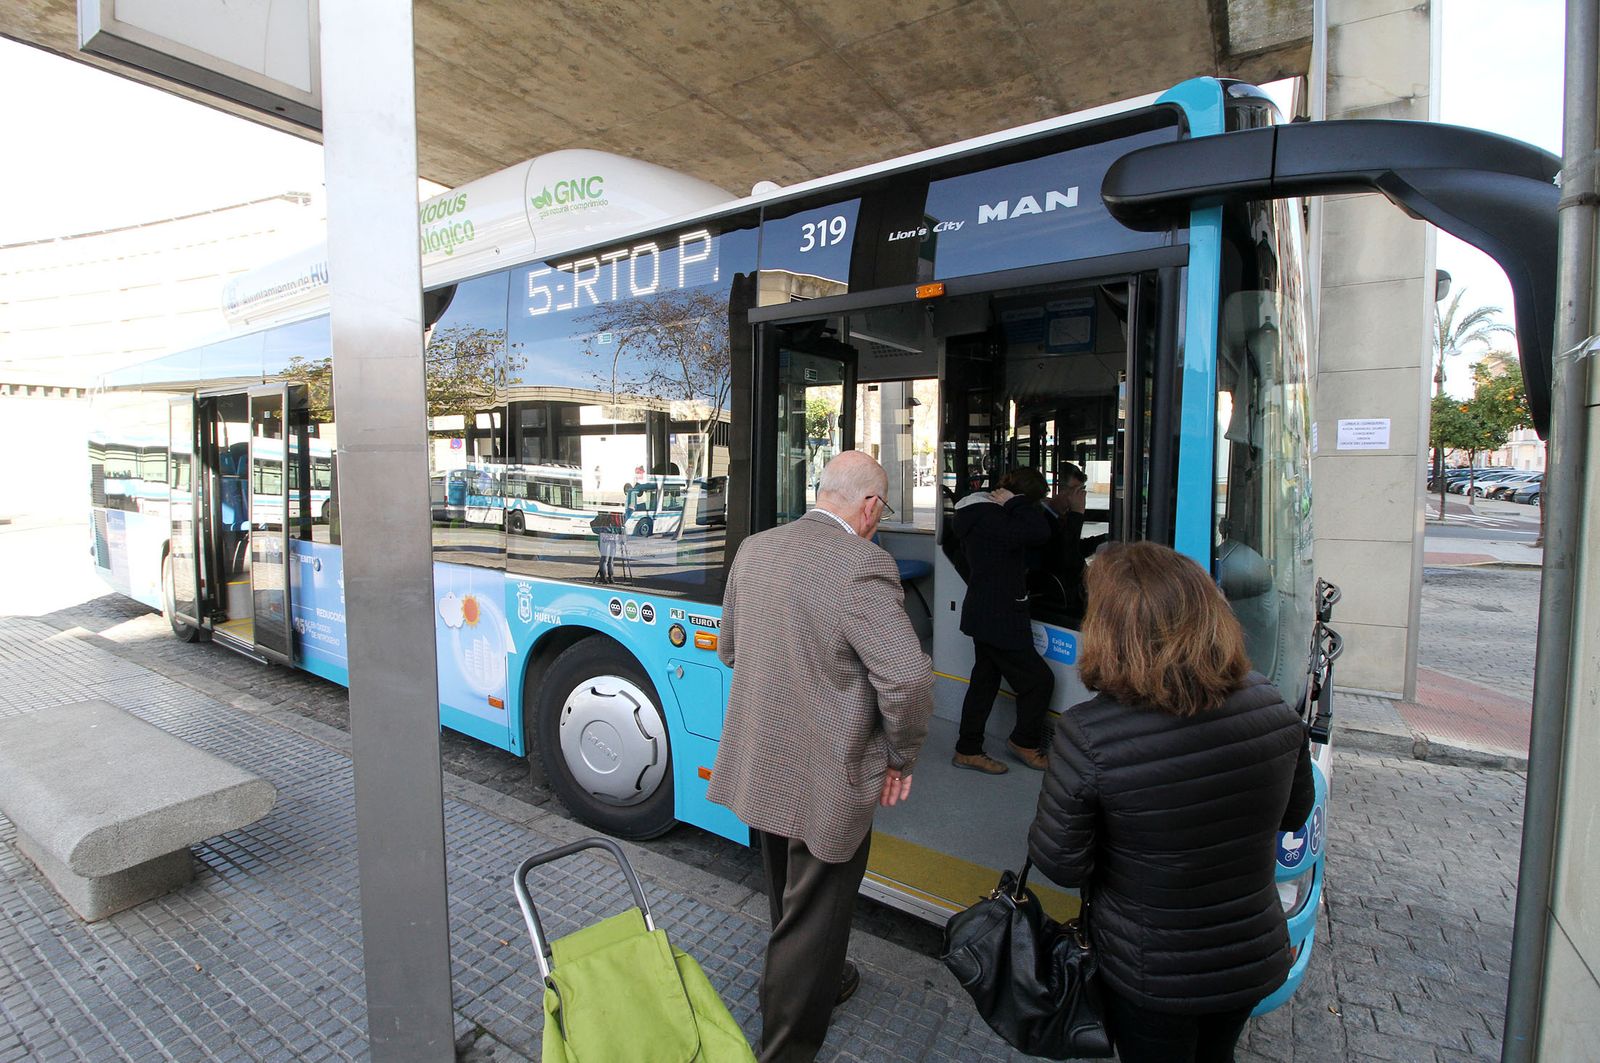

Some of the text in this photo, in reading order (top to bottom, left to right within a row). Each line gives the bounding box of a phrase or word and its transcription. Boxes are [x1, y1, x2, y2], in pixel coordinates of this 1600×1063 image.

[554, 175, 604, 204] GNC
[978, 186, 1079, 225] MAN
[799, 215, 848, 252] 319
[888, 219, 965, 242] Lion's City
[534, 611, 562, 626] HUELVA
[691, 617, 713, 627] EURO
